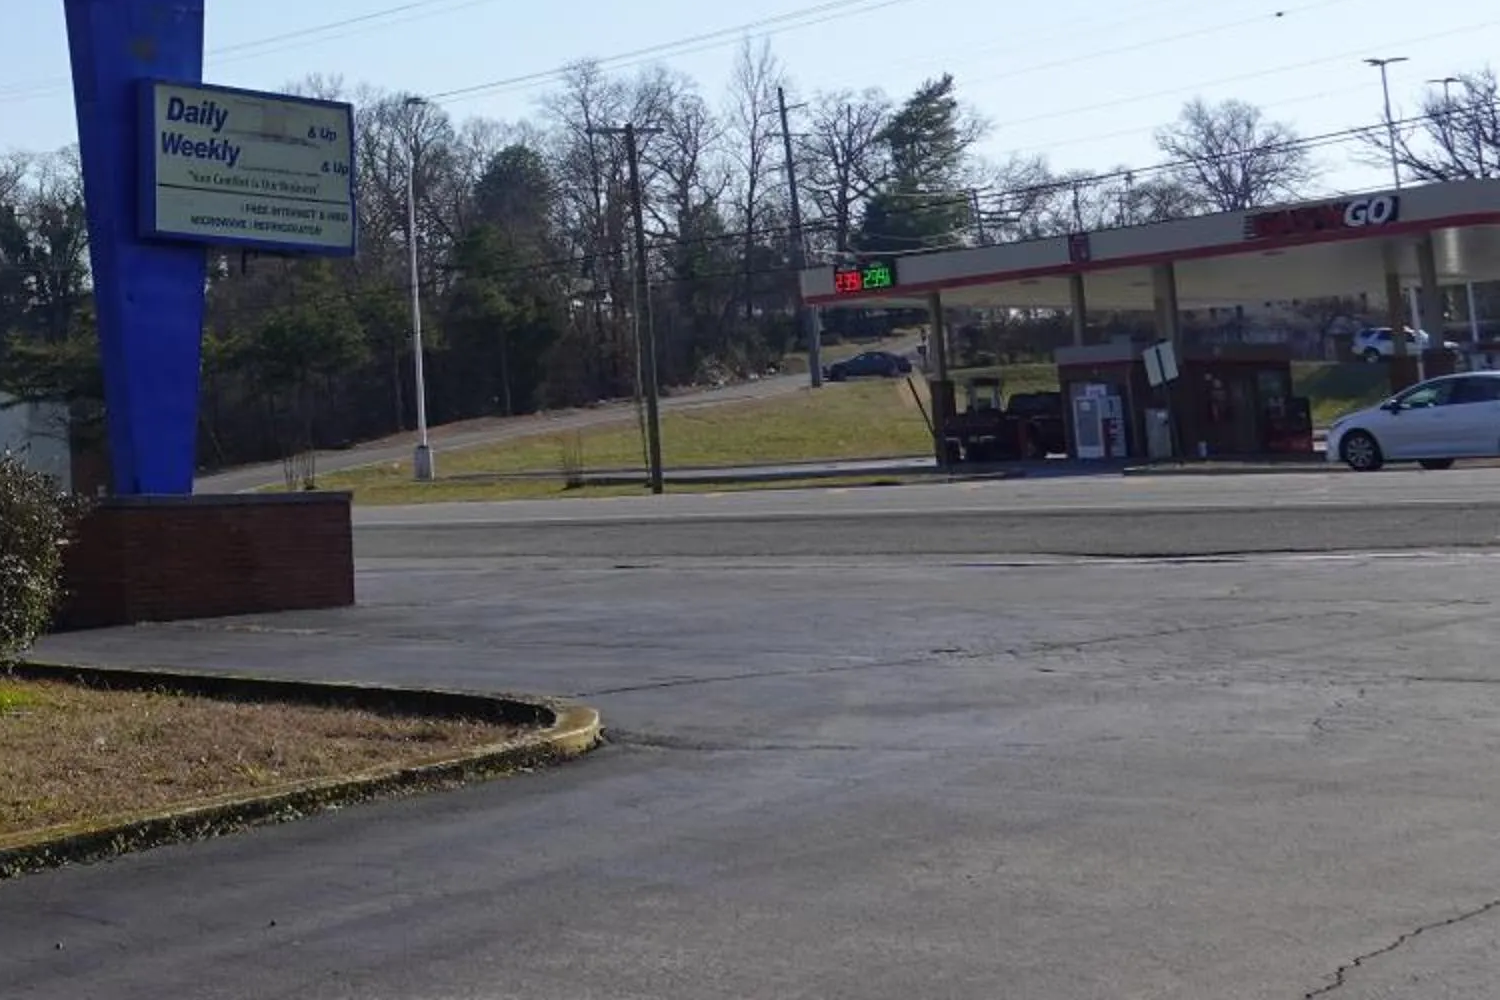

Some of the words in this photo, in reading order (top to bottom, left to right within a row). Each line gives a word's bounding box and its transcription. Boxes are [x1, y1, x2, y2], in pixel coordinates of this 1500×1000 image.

[167, 96, 229, 133] Daily
[308, 126, 317, 139] &
[320, 127, 337, 142] Up
[161, 131, 241, 169] Weekly
[321, 161, 330, 174] &
[333, 161, 349, 176] Up
[1344, 196, 1393, 227] GO
